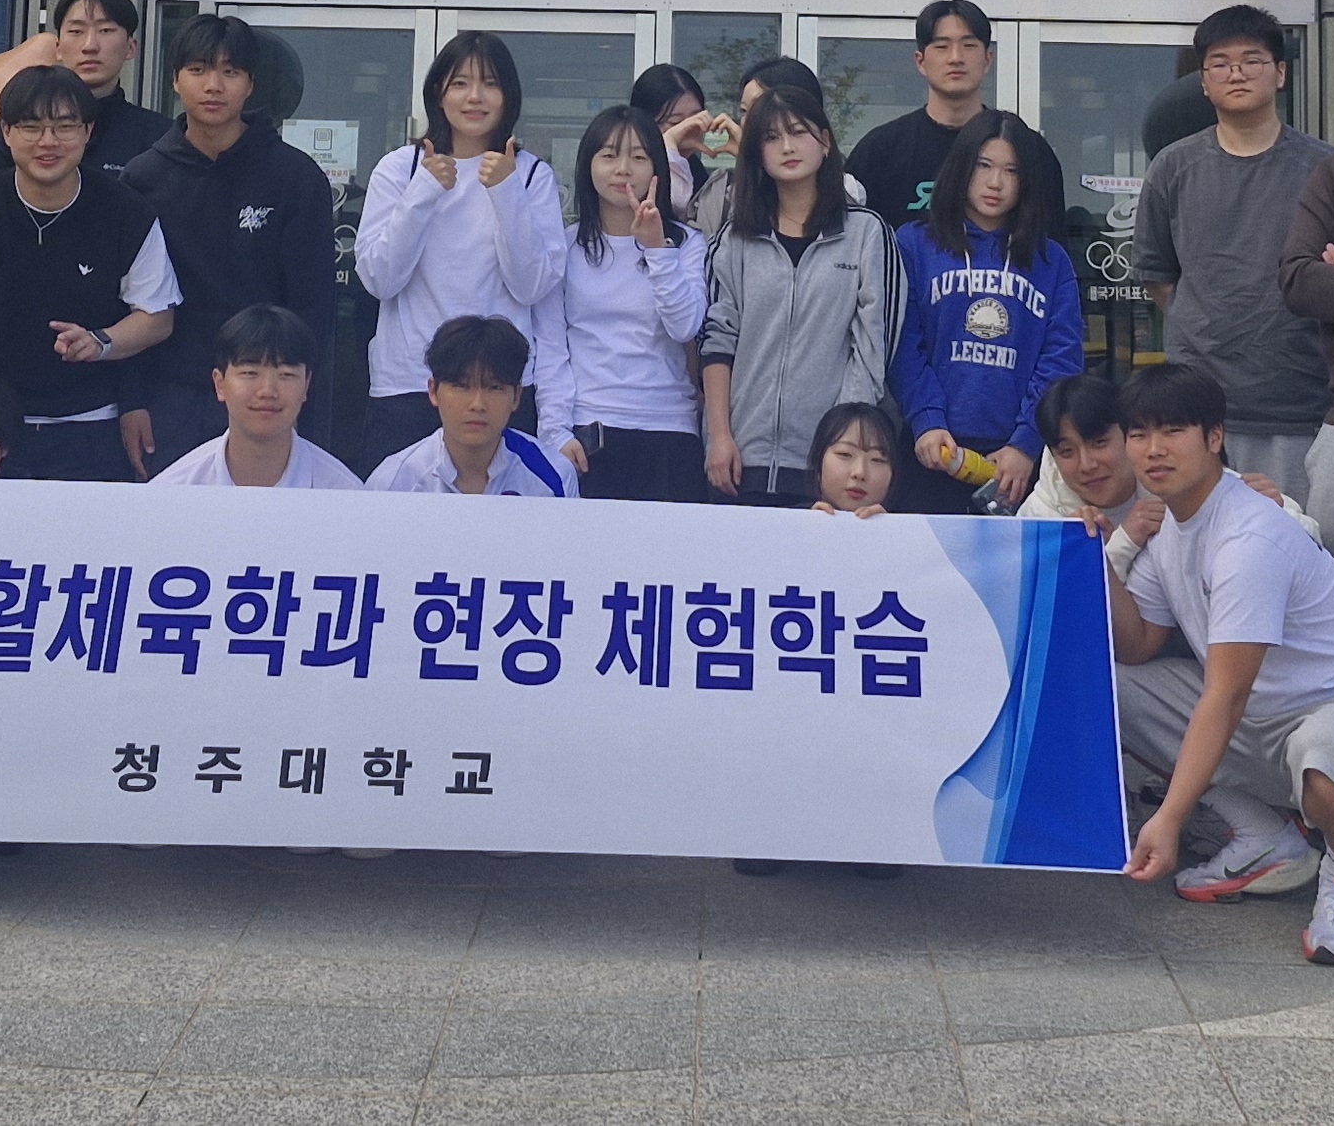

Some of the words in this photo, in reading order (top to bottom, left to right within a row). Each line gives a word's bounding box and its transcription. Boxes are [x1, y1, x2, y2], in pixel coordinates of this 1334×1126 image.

[931, 268, 1047, 319] AUTHENTIC
[950, 340, 1017, 370] LEGEND
[413, 572, 573, 685] 현장
[595, 581, 928, 698] 체험학습
[112, 742, 493, 796] 청주대학교
